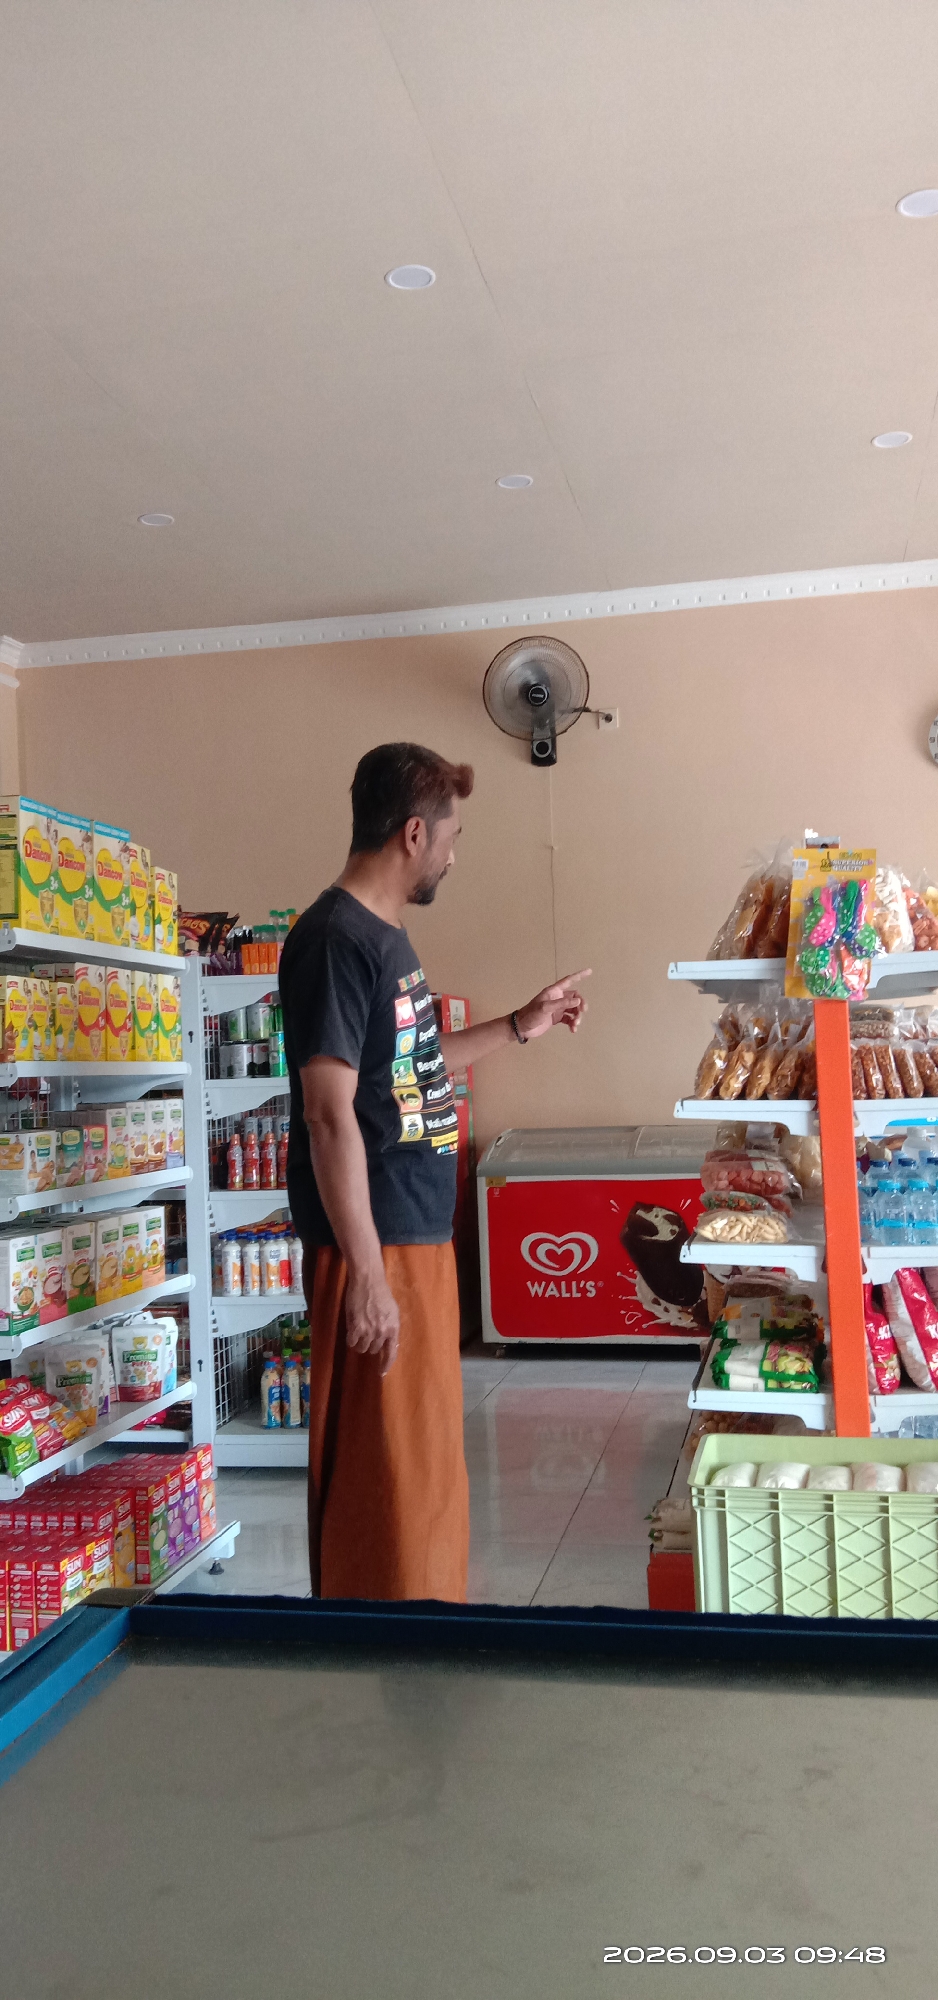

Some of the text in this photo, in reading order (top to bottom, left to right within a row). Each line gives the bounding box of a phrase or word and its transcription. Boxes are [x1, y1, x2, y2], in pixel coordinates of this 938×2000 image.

[24, 839, 52, 863] Dancow
[58, 850, 86, 873] Dancow
[97, 861, 123, 881] Dancow
[526, 1280, 597, 1298] WALL'S
[123, 1350, 158, 1363] Promina
[3, 1407, 26, 1427] SUN
[93, 1541, 109, 1558] SUN
[66, 1557, 82, 1576] SUN
